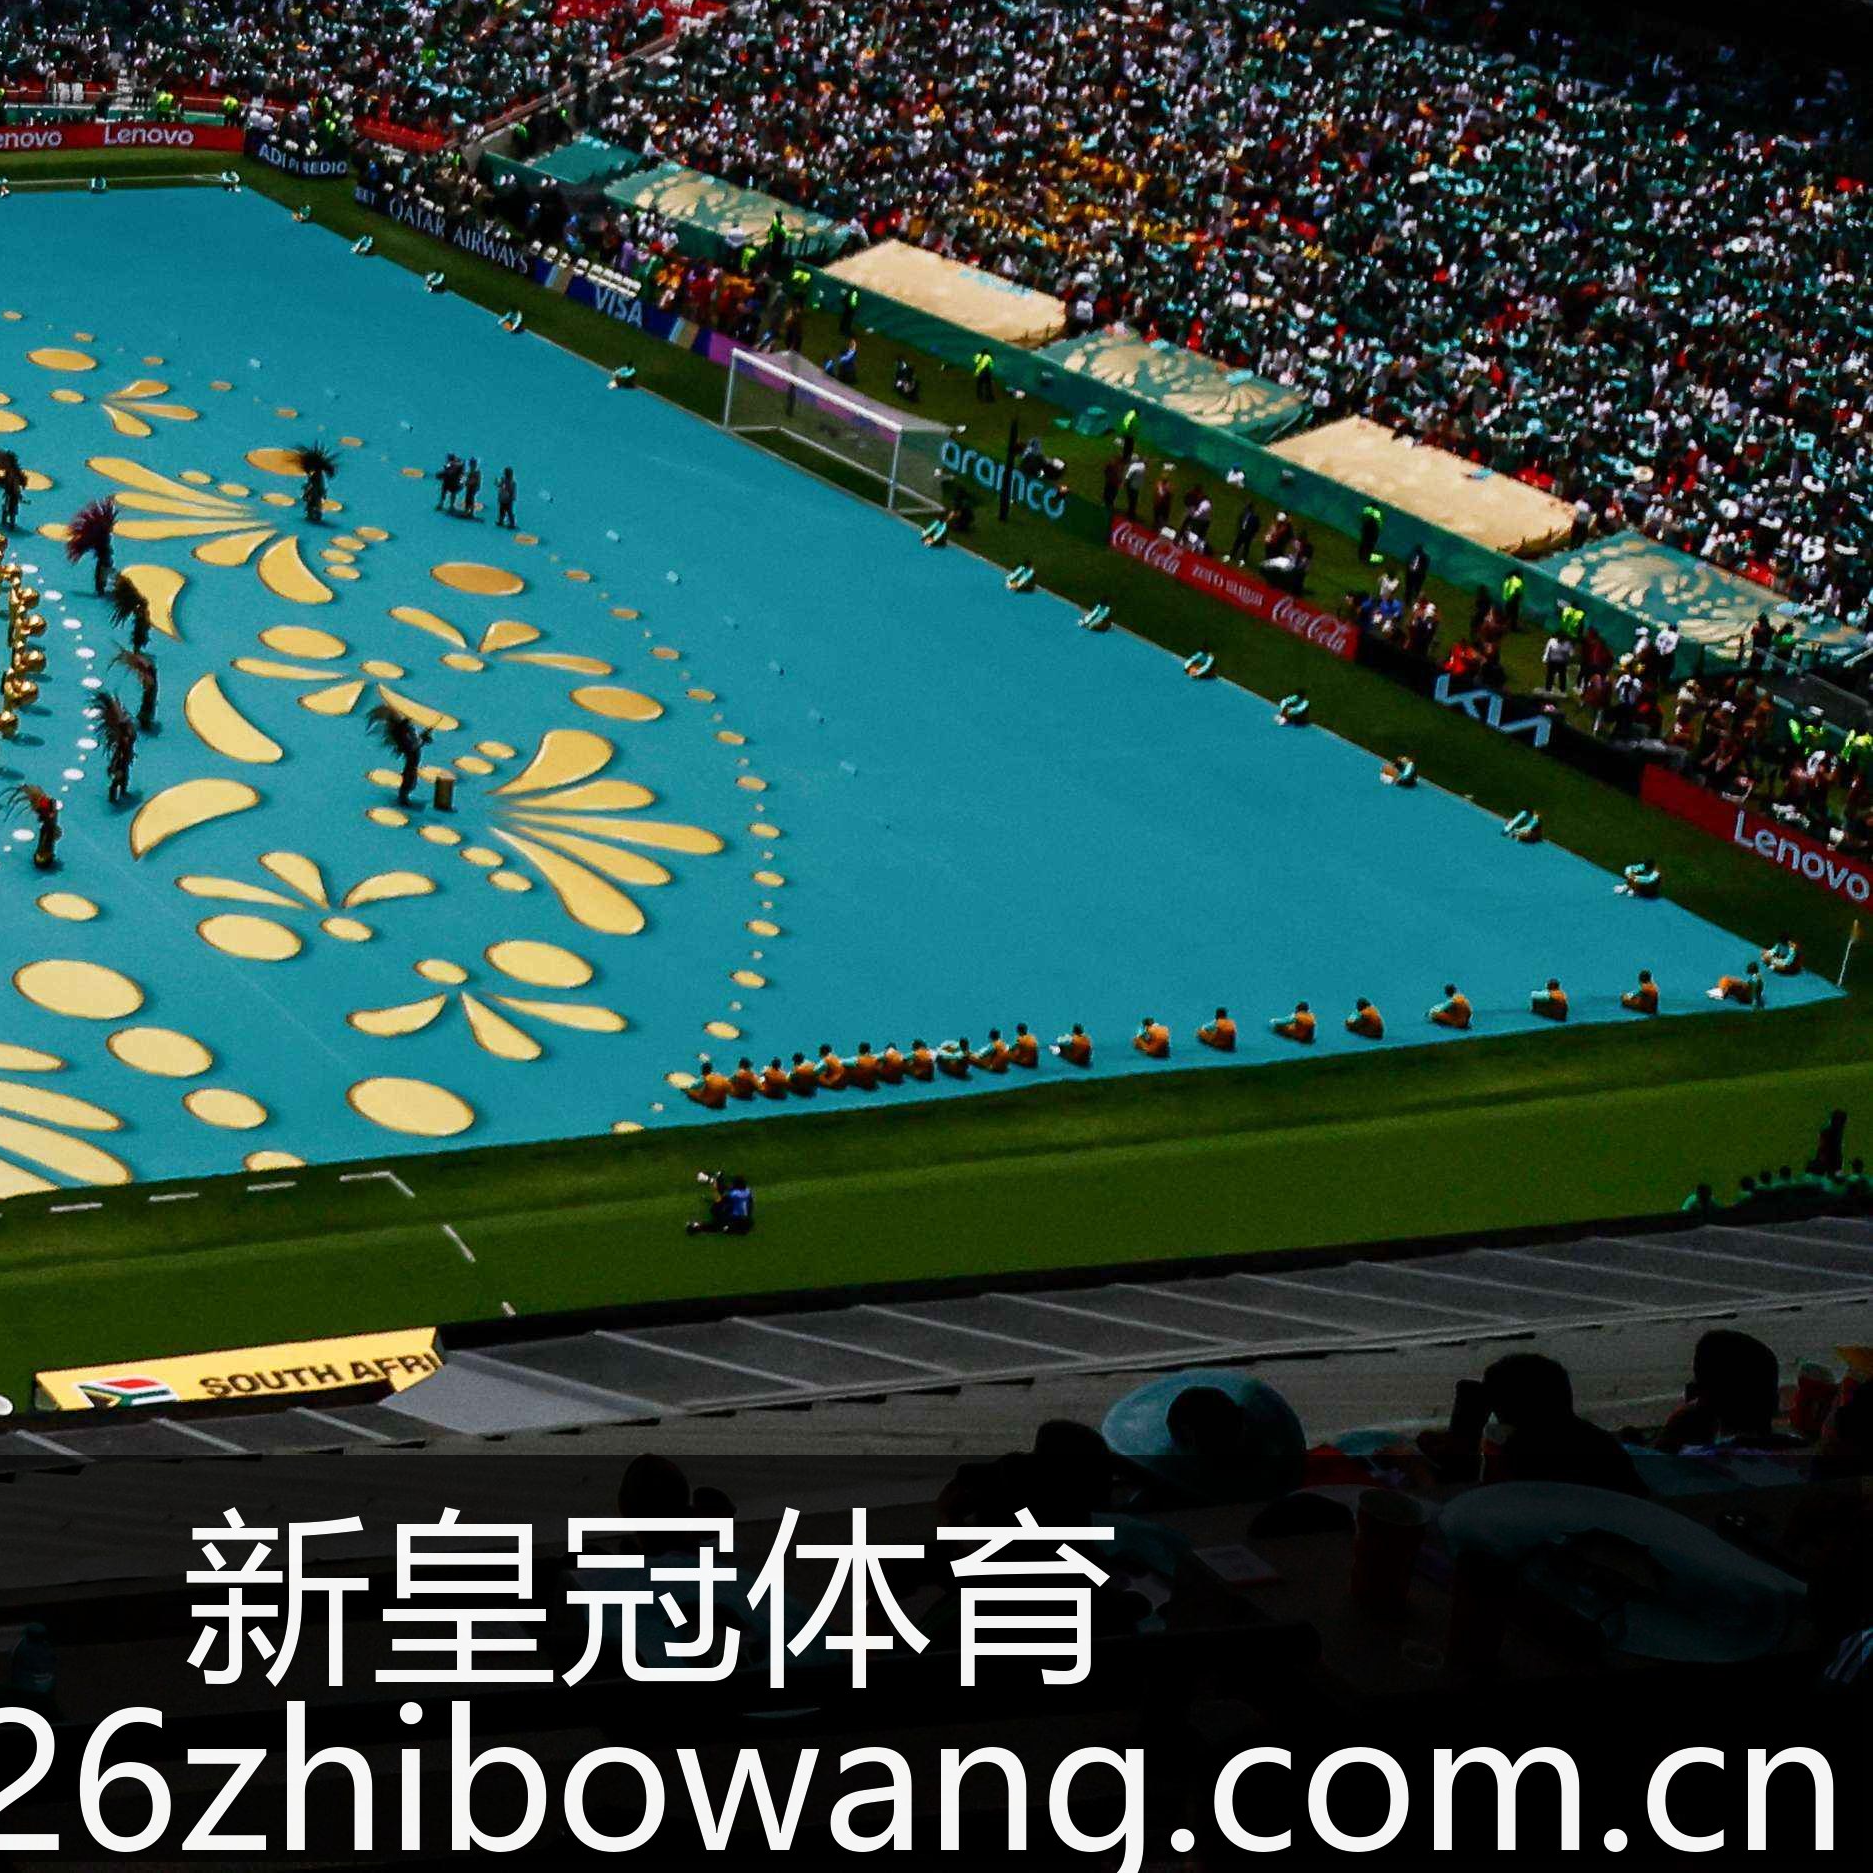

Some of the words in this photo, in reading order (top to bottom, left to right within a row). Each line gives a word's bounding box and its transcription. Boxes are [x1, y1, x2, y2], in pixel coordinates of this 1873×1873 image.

[102, 124, 195, 146] Lenovo
[388, 196, 446, 239] QATAR
[452, 224, 529, 275] AIRWAYS
[594, 283, 644, 329] VISA
[940, 439, 1066, 519] aramco
[1433, 672, 1553, 748] KIA
[1733, 809, 1871, 903] Lenovo
[198, 1362, 344, 1399] SOUTH
